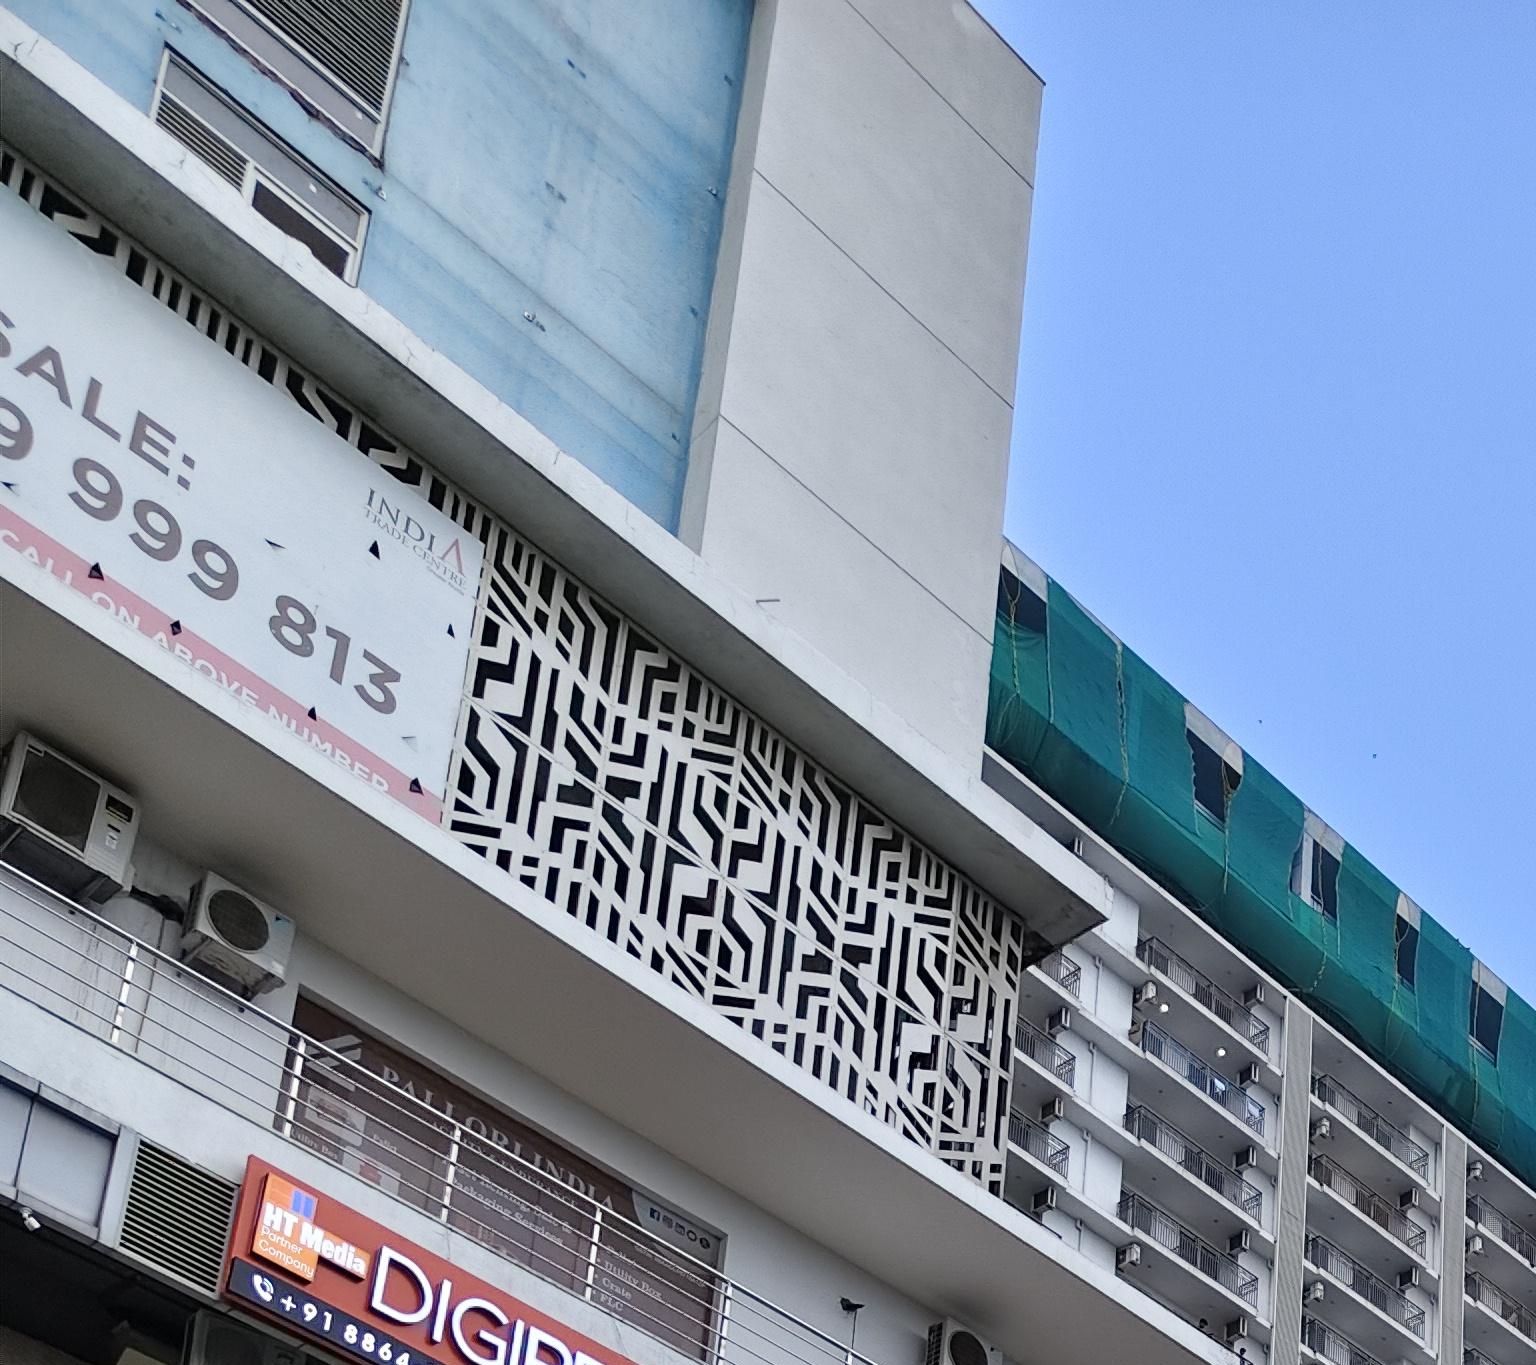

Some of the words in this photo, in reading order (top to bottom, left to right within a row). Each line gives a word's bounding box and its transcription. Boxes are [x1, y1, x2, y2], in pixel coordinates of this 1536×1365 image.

[364, 505, 409, 548] TRADE
[412, 545, 467, 590] CENTRE
[68, 457, 239, 601] 999
[269, 595, 401, 714] 813
[153, 631, 260, 706] ABOVE
[267, 704, 390, 792] NUMBER
[258, 1239, 315, 1278] Company
[261, 1226, 304, 1255] Partner
[264, 1202, 298, 1237] HT
[300, 1220, 367, 1276] Media
[602, 1277, 632, 1299] Crate
